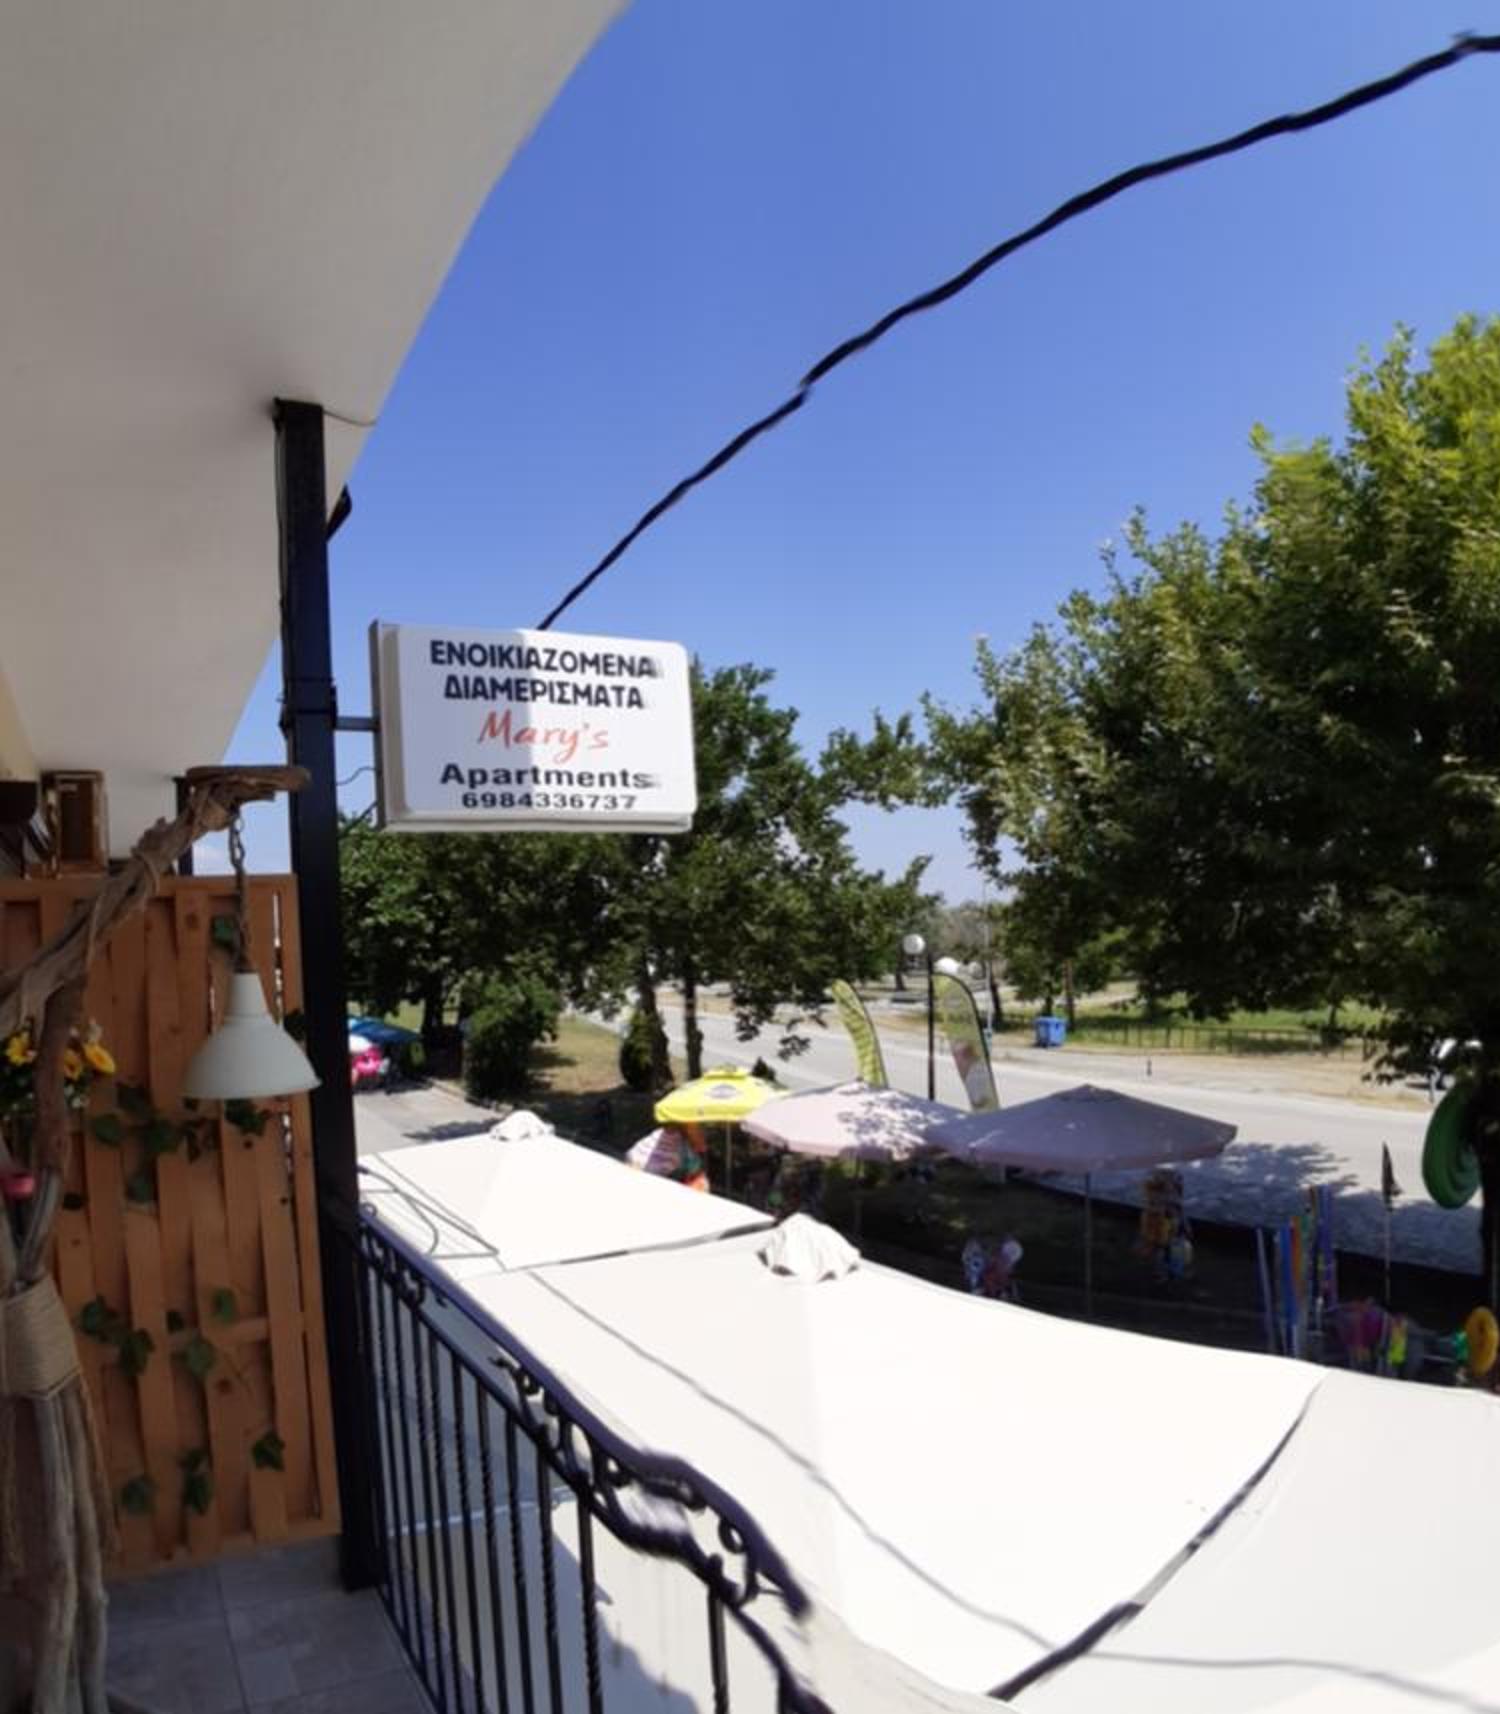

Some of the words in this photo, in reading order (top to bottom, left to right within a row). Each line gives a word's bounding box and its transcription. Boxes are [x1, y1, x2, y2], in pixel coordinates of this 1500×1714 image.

[430, 640, 658, 678] ΕΝΟΙΚΙΑΖΟΜΕΝΑ
[444, 675, 644, 709] ΔΙΑΜΕΡΙΣΜΑΤΑ
[477, 709, 609, 763] Mary's
[440, 763, 657, 790] Apartments
[462, 792, 637, 810] 6984336737
